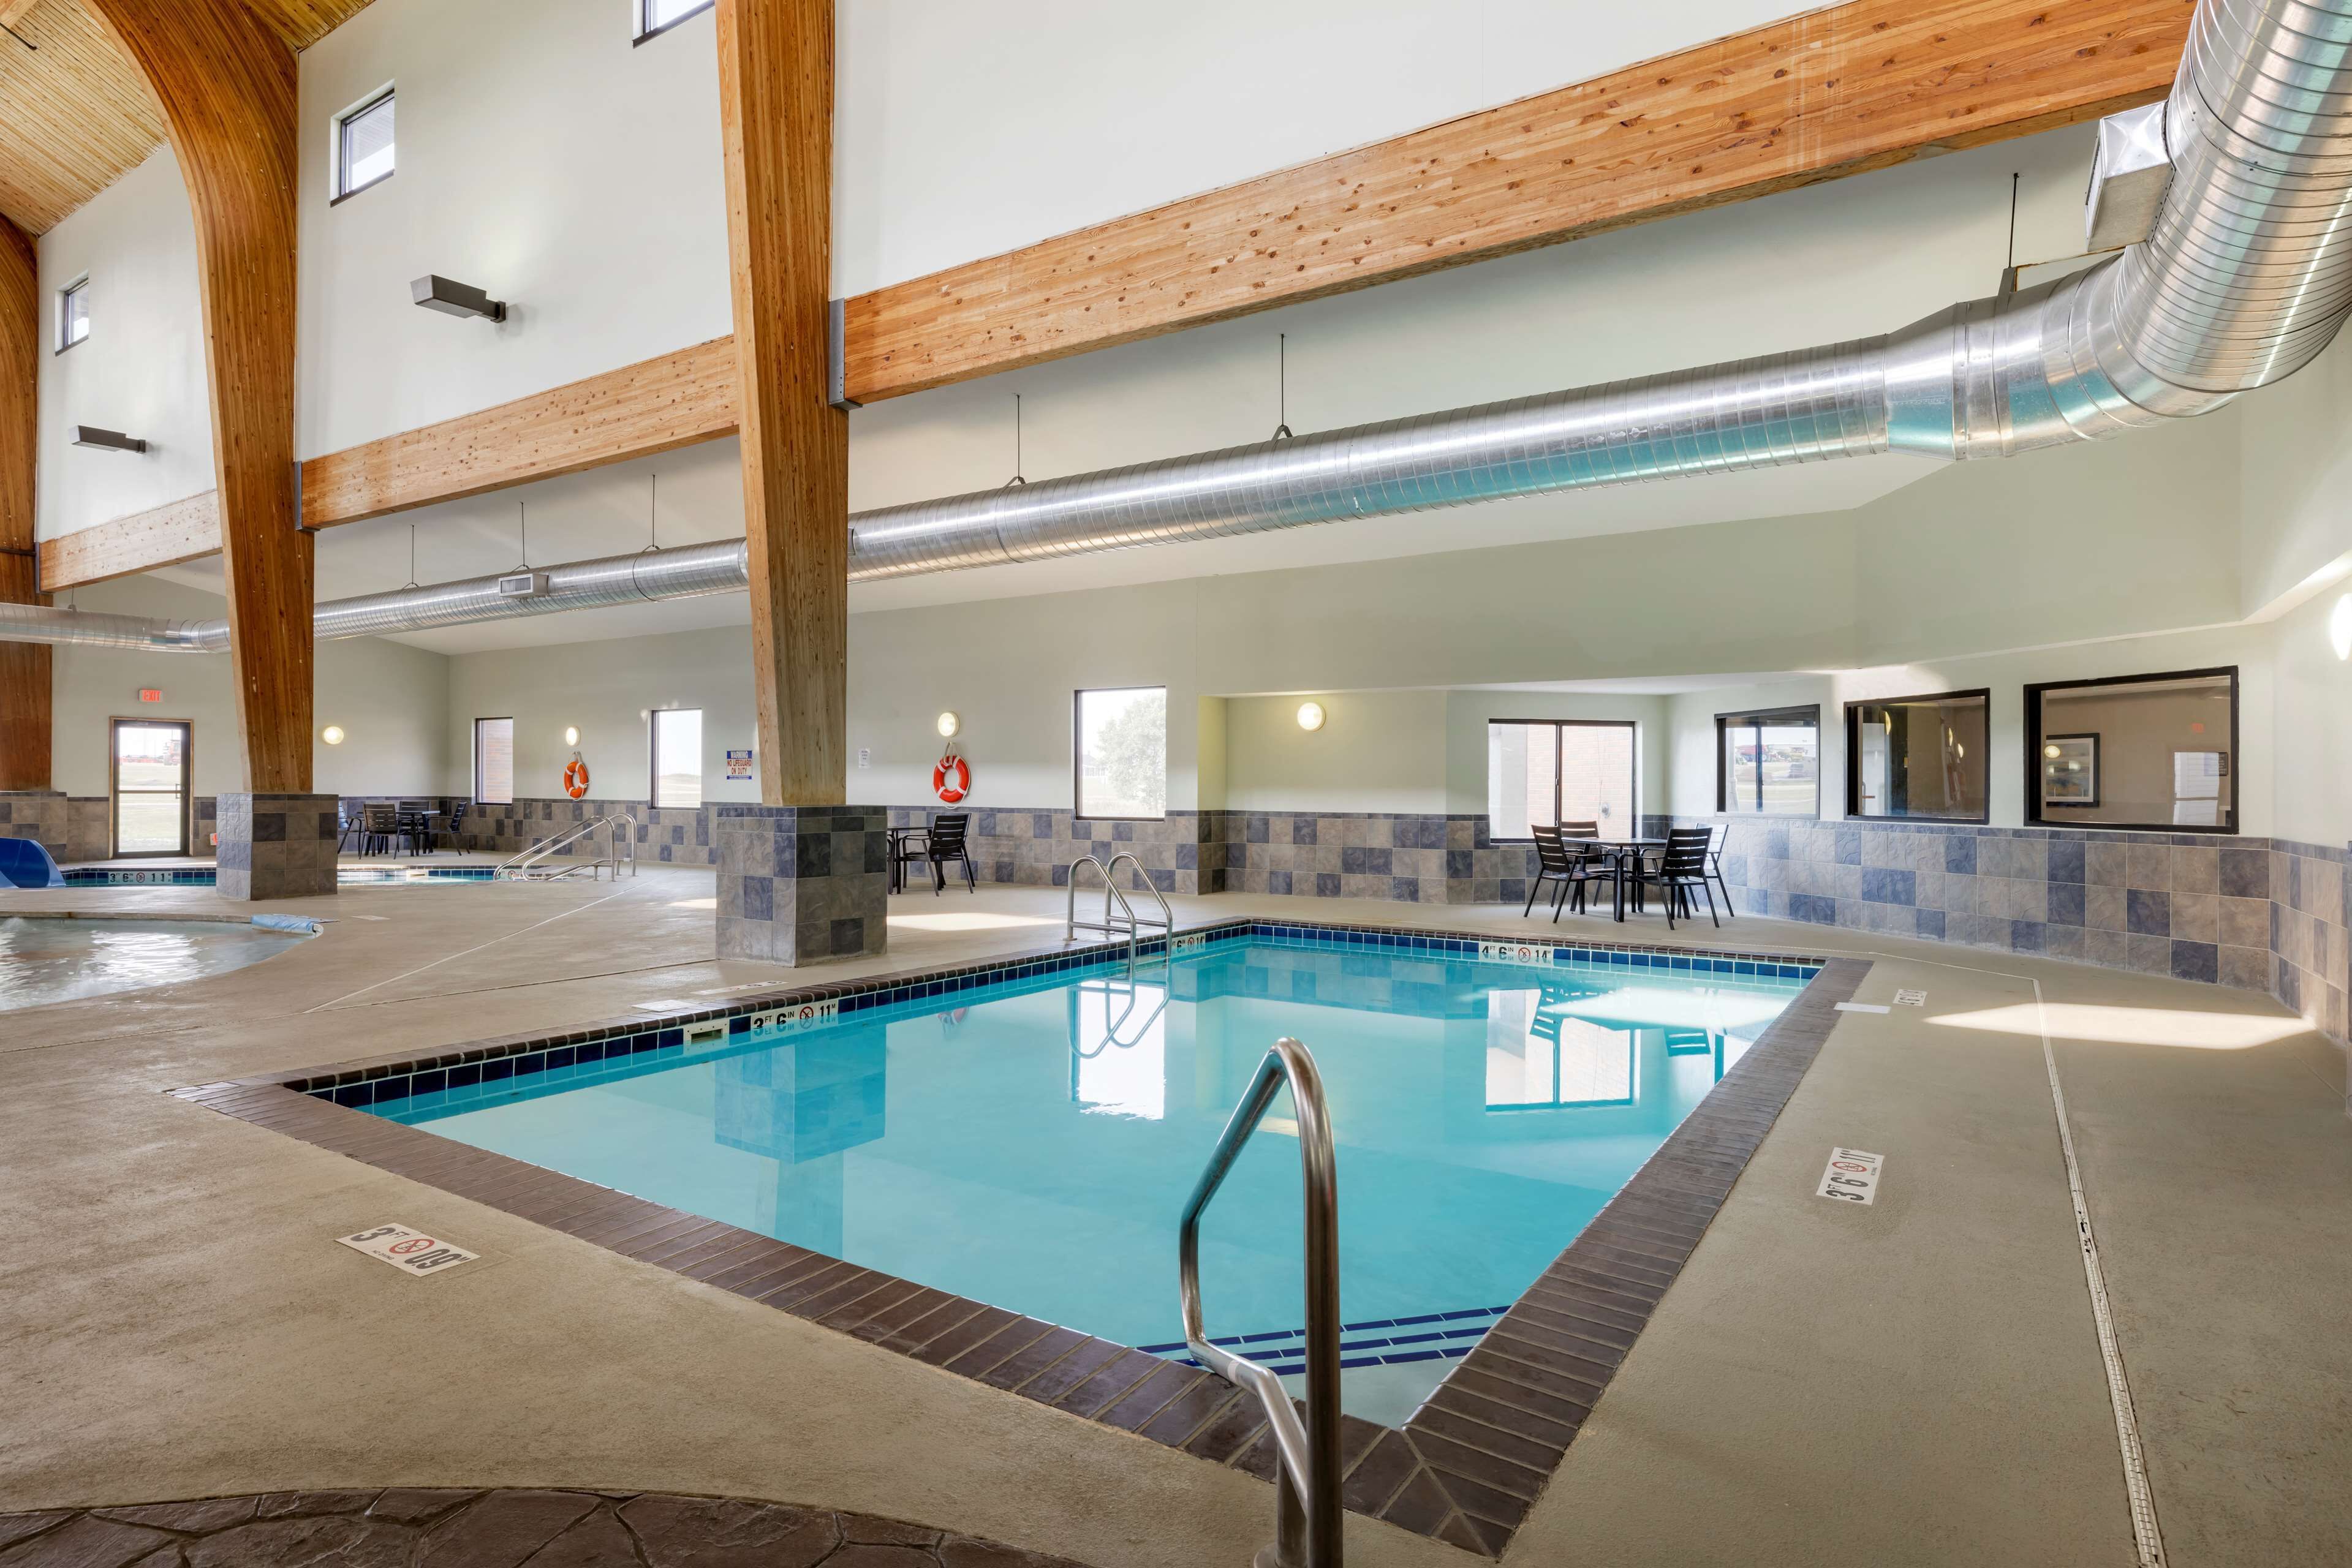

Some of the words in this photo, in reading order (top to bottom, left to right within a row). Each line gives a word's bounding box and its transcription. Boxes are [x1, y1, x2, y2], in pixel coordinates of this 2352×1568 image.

[143, 690, 161, 702] EXIT
[776, 1013, 787, 1025] 6
[1831, 1177, 1869, 1187] 6
[1826, 1189, 1864, 1200] 3
[350, 1227, 396, 1242] 3
